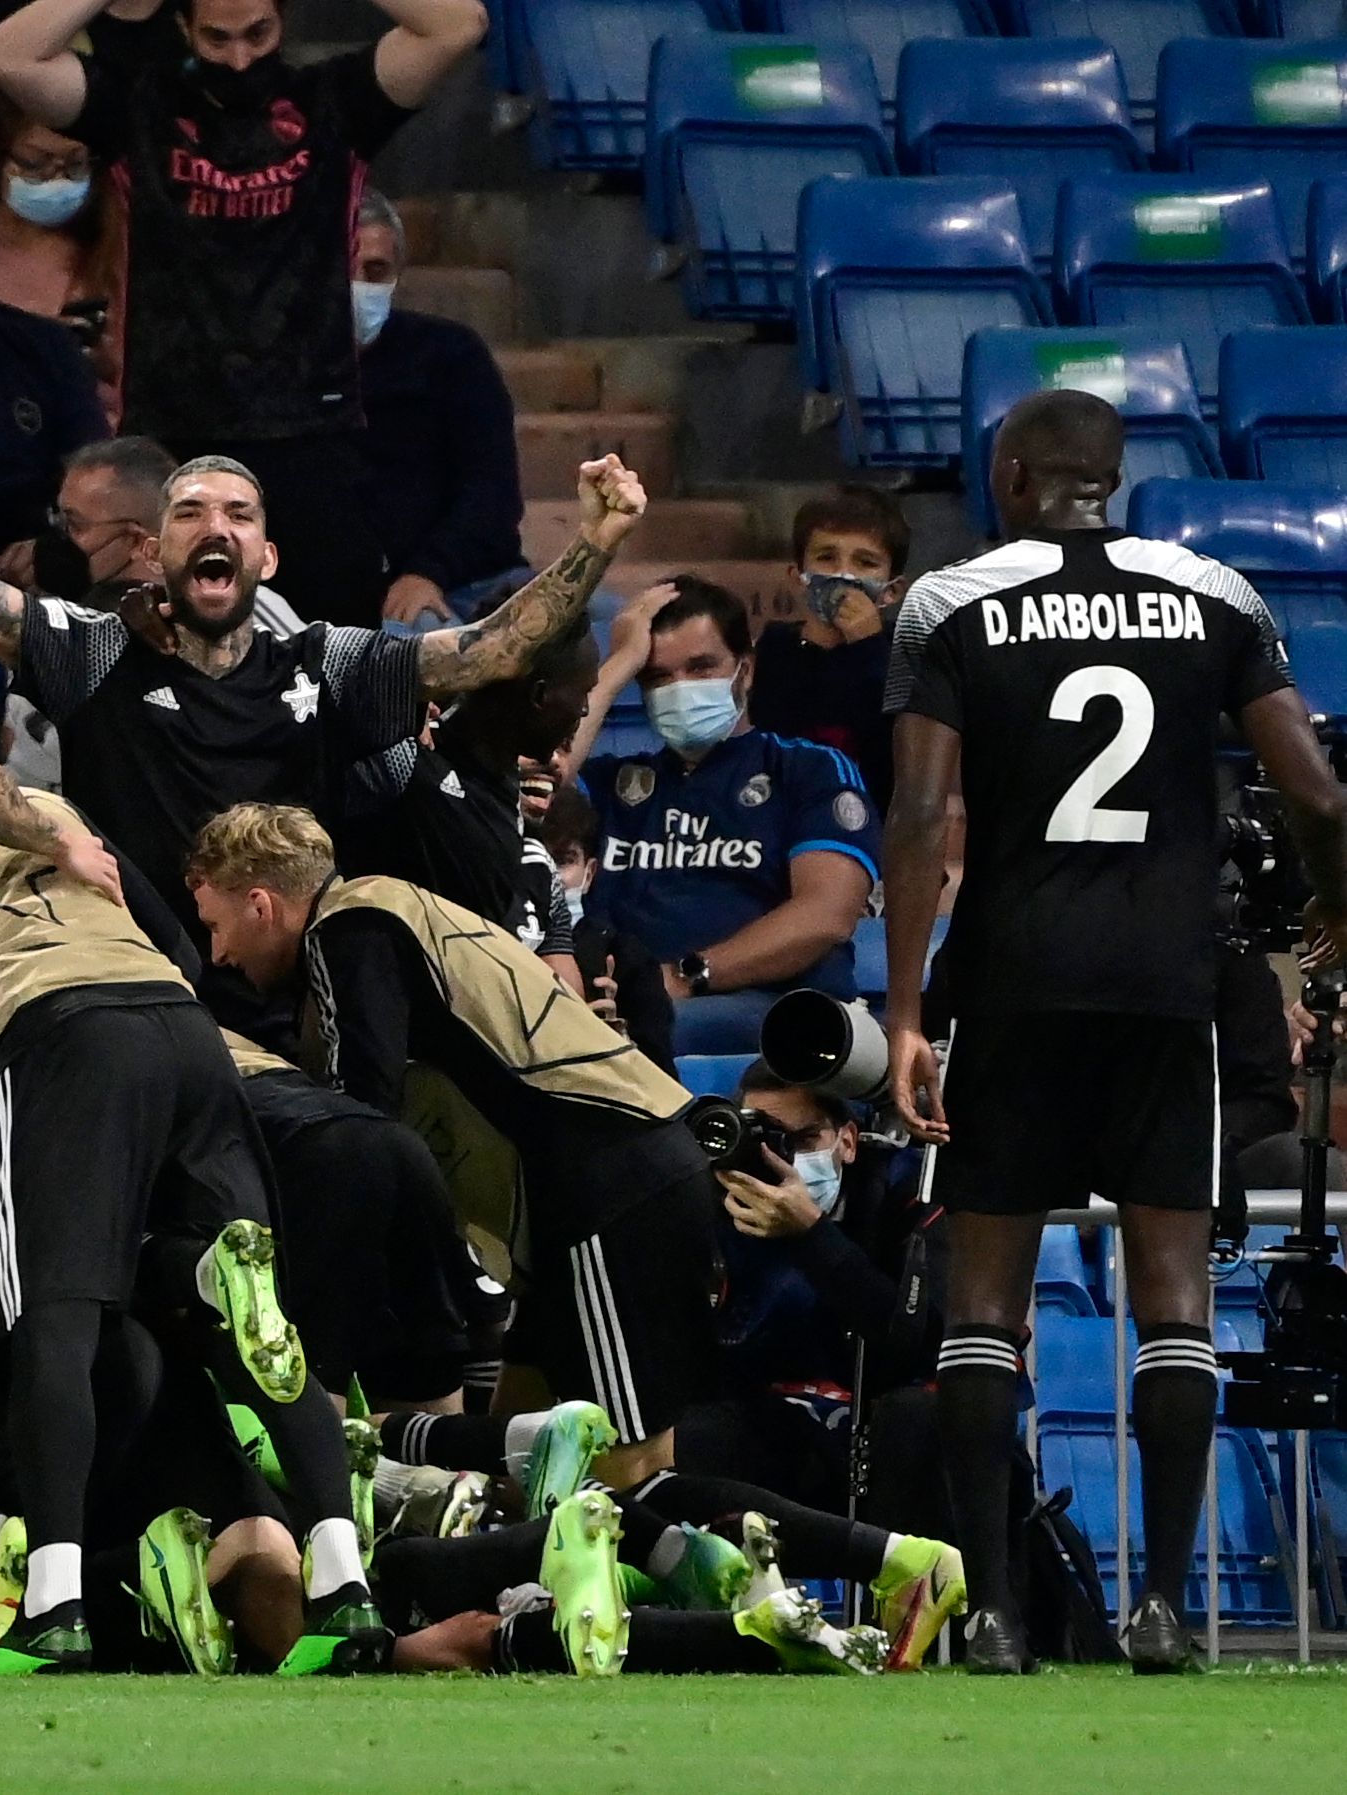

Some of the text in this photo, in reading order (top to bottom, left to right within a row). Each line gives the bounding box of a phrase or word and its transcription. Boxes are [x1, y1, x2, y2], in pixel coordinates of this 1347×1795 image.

[1045, 665, 1155, 843] 2
[664, 808, 710, 841] Fly
[603, 832, 763, 872] Emirates
